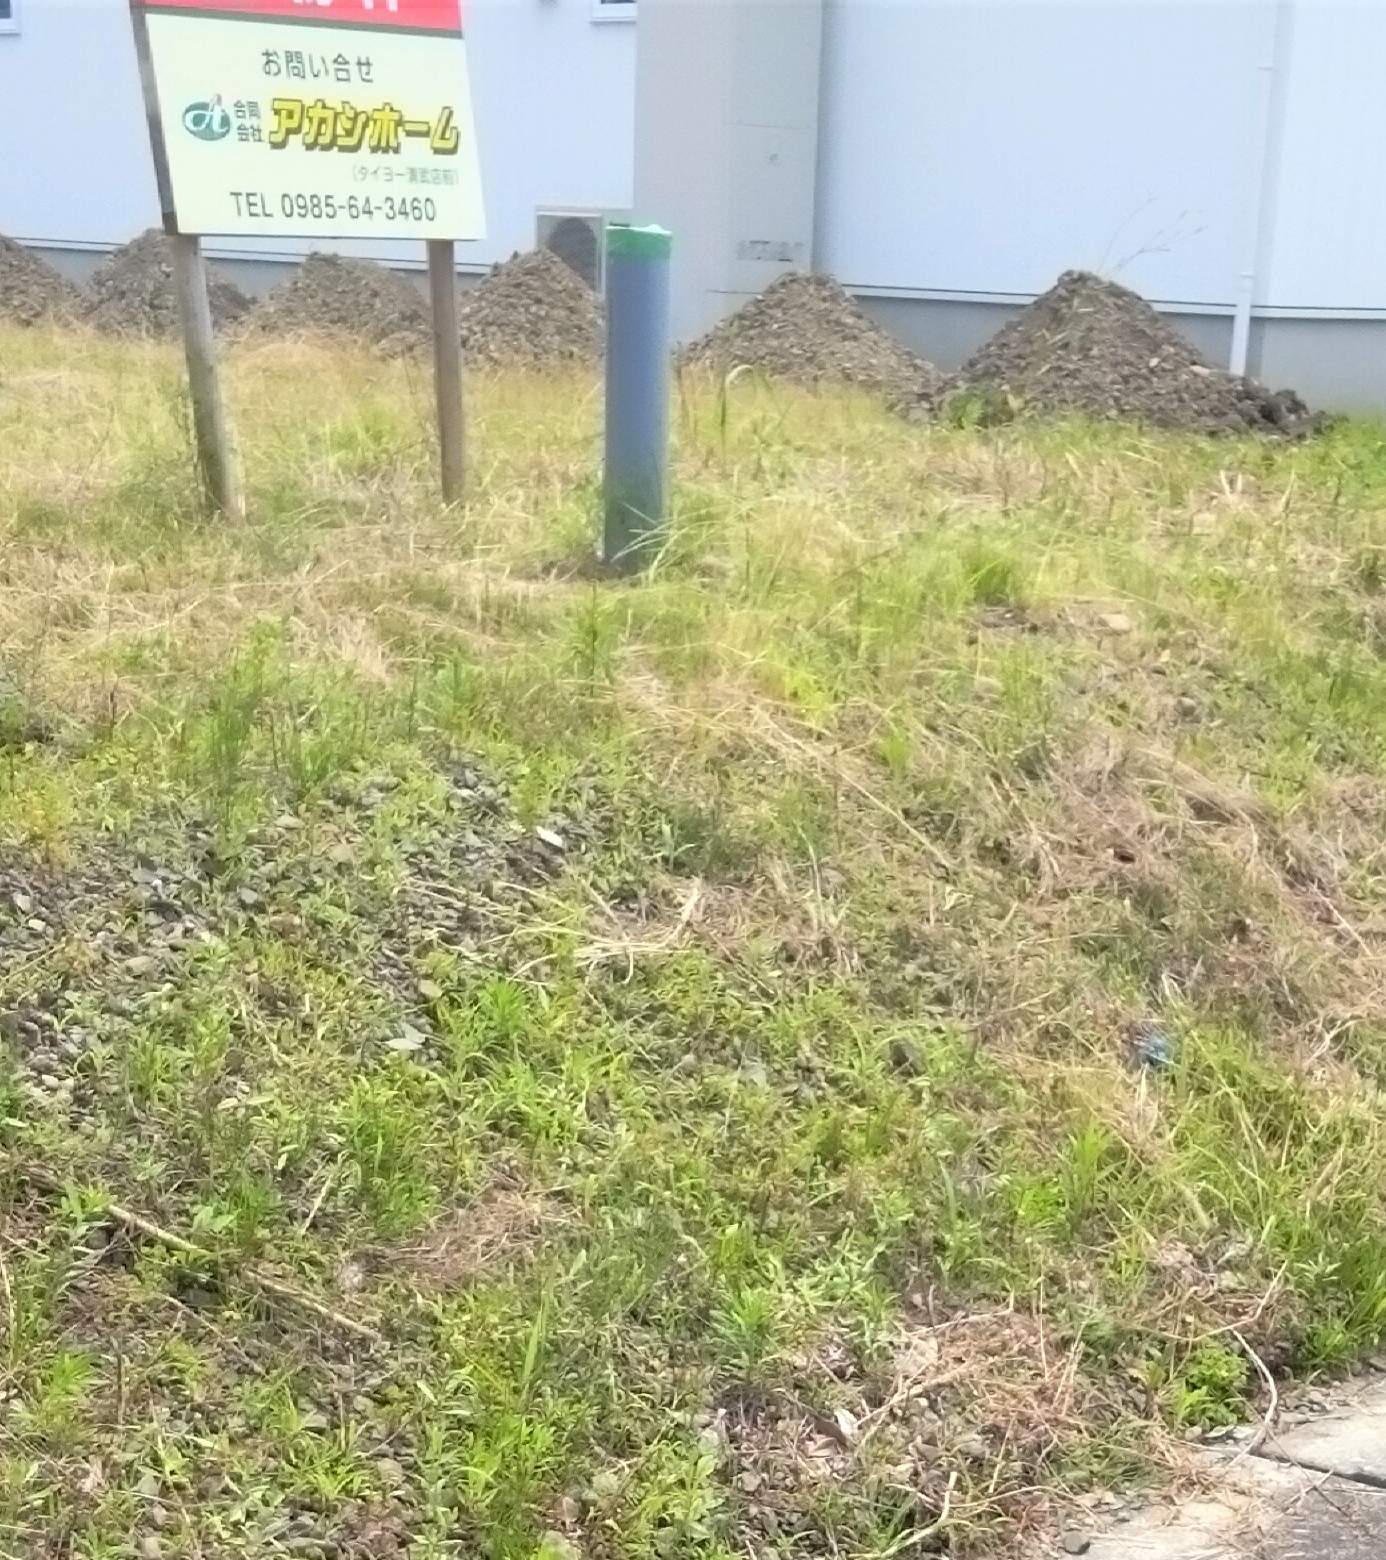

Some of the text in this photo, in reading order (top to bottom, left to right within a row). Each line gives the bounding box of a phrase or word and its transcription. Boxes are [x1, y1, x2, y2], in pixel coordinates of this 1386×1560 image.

[261, 48, 374, 83] お問い合せ
[269, 98, 460, 155] アカシホーム
[230, 191, 437, 222] TEL 0985-64-3460
